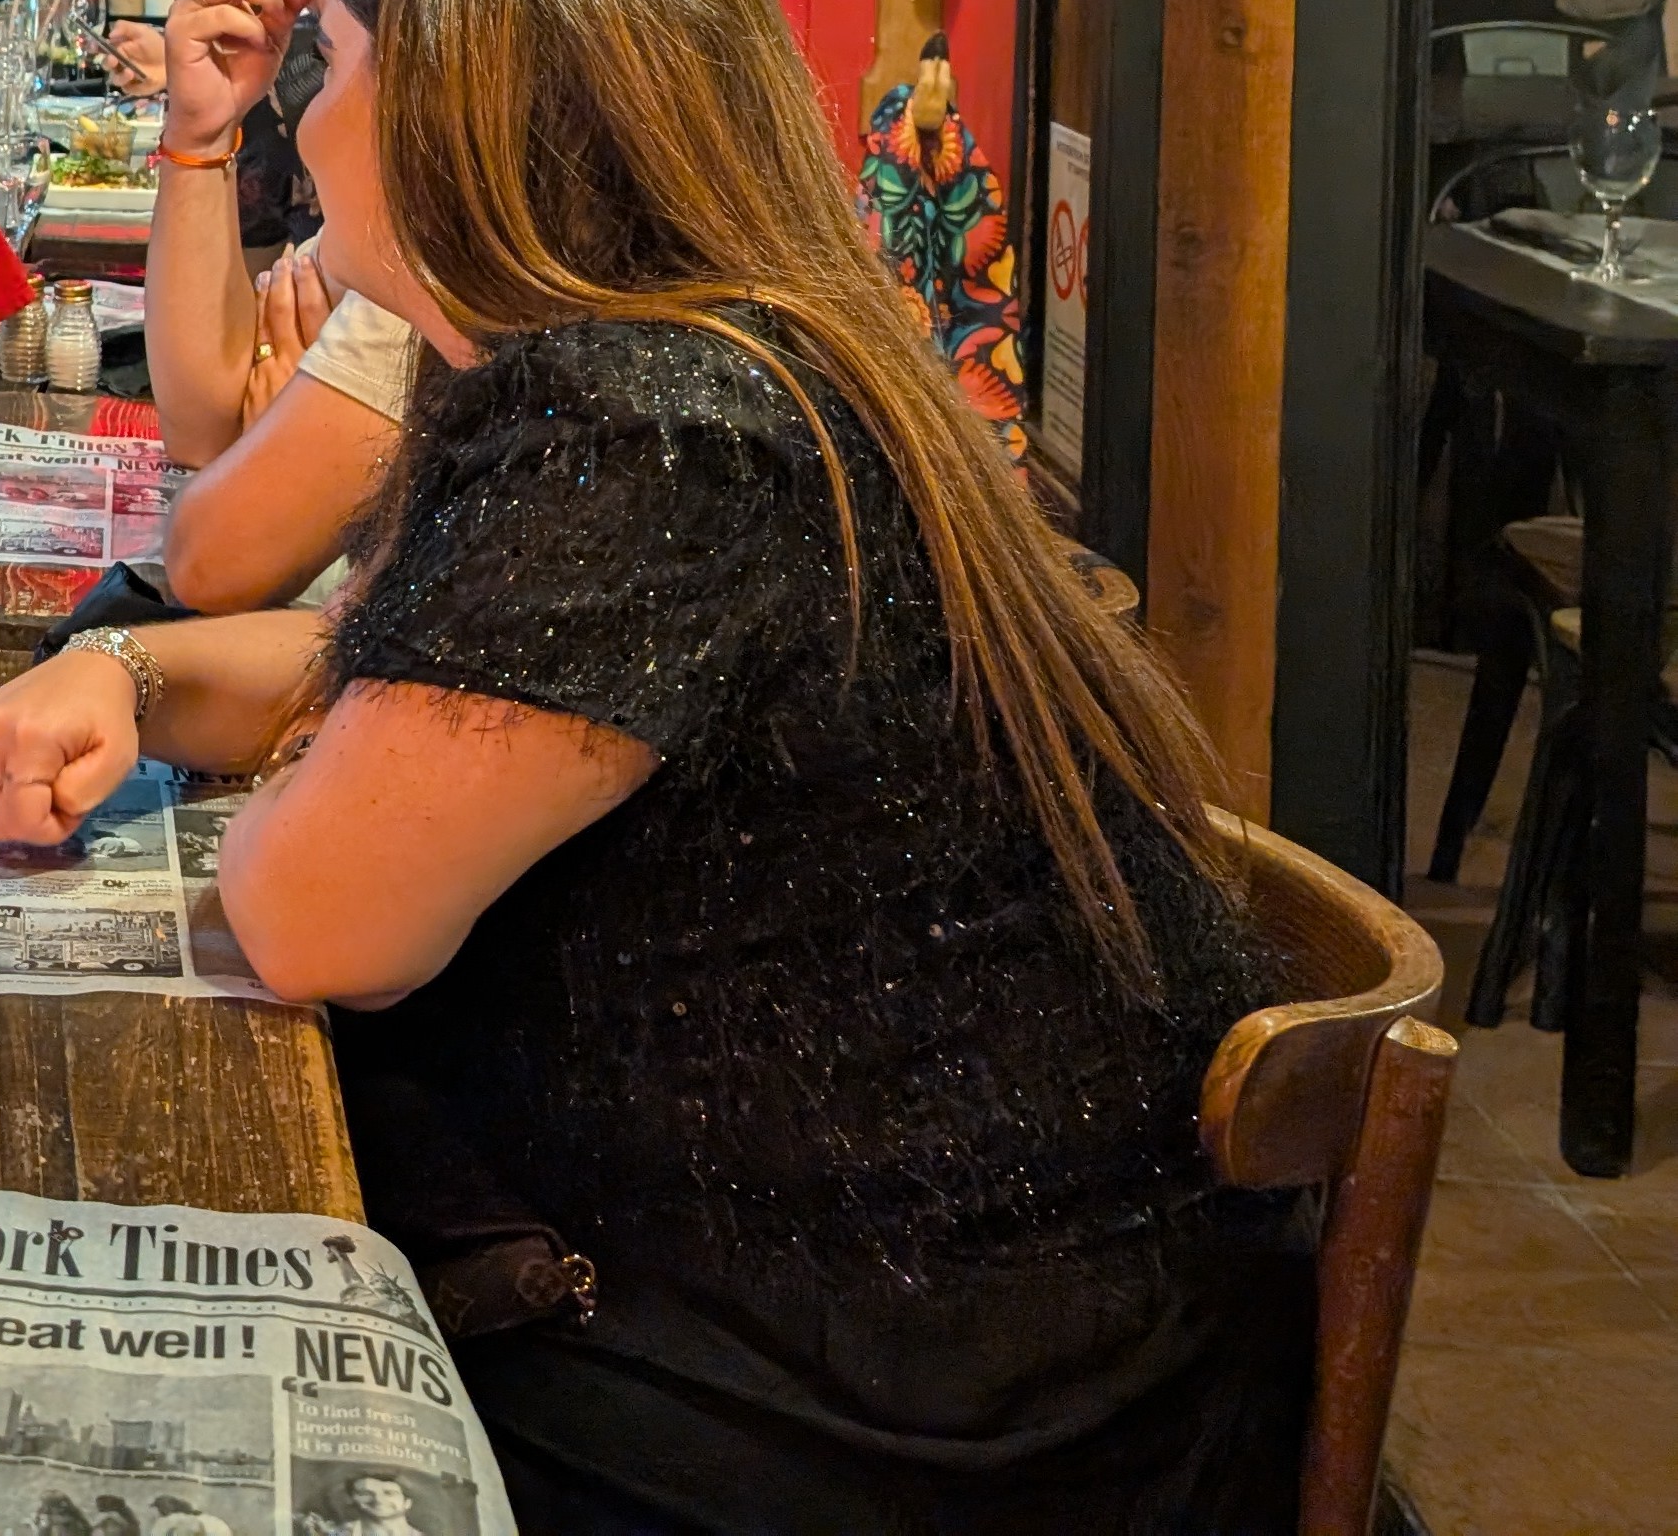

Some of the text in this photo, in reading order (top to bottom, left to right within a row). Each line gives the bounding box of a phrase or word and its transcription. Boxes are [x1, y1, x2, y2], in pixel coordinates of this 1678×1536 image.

[33, 431, 128, 455] Times
[30, 455, 92, 467] well
[115, 458, 188, 476] NEWS
[110, 1223, 314, 1291] Times
[99, 1325, 226, 1359] well
[241, 1325, 255, 1359] !
[294, 1326, 453, 1408] NEWS
[296, 1399, 417, 1429] To find fresh
[296, 1420, 383, 1440] products
[388, 1429, 407, 1443] in
[316, 1438, 333, 1454] is
[337, 1441, 425, 1462] possible
